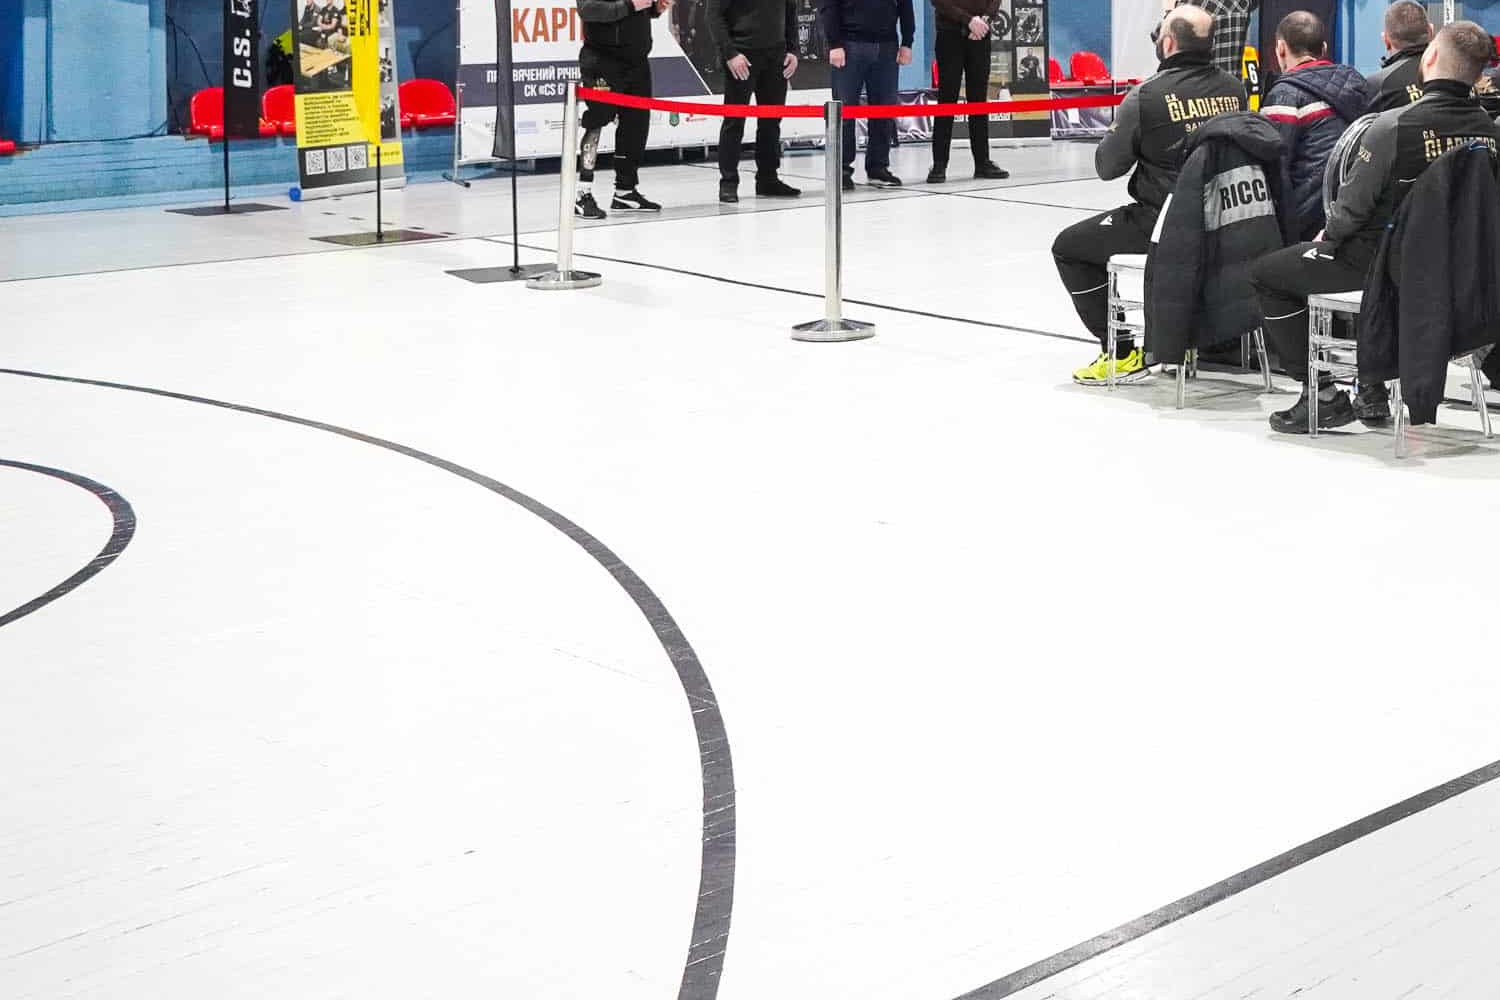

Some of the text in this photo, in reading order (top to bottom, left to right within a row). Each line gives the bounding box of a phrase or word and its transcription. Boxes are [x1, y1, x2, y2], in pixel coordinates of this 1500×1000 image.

[233, 28, 252, 88] C.S.
[487, 64, 555, 83] ПВЯЧЕНИЙ
[524, 84, 537, 97] СК
[1168, 96, 1239, 122] GLADIATOR
